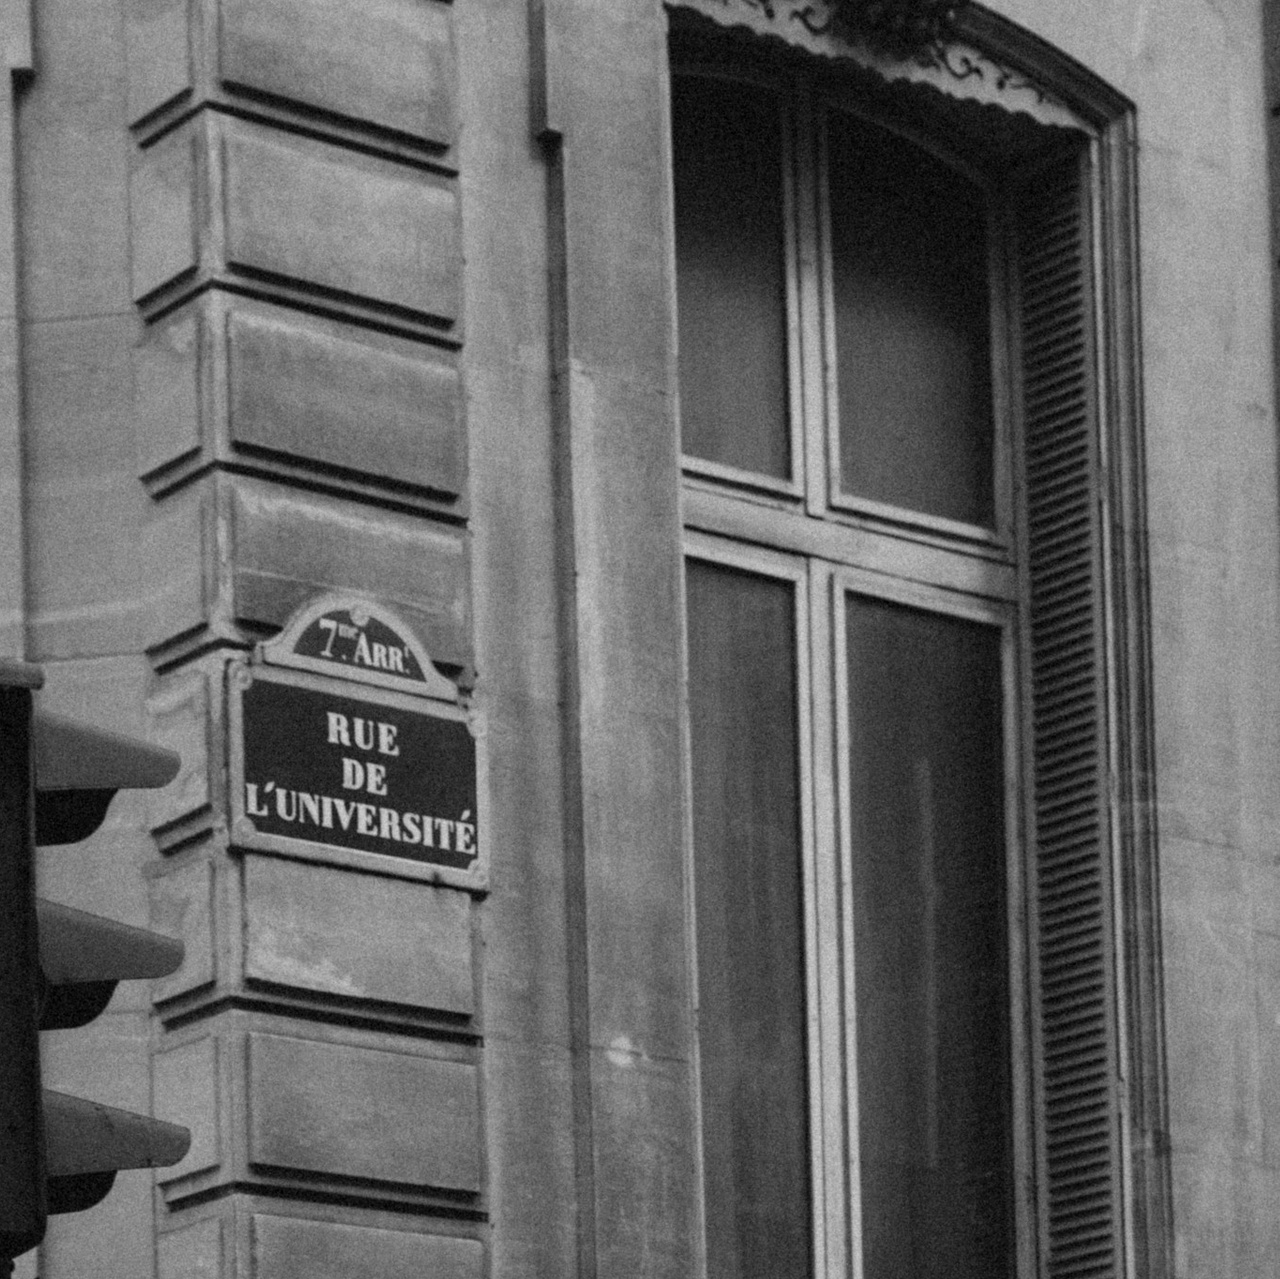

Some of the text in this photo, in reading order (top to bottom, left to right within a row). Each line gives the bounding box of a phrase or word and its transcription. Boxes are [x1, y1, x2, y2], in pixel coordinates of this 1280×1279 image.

[326, 711, 399, 756] RUE
[341, 757, 388, 796] DE
[245, 781, 477, 855] L'UNIVERSITÉ
